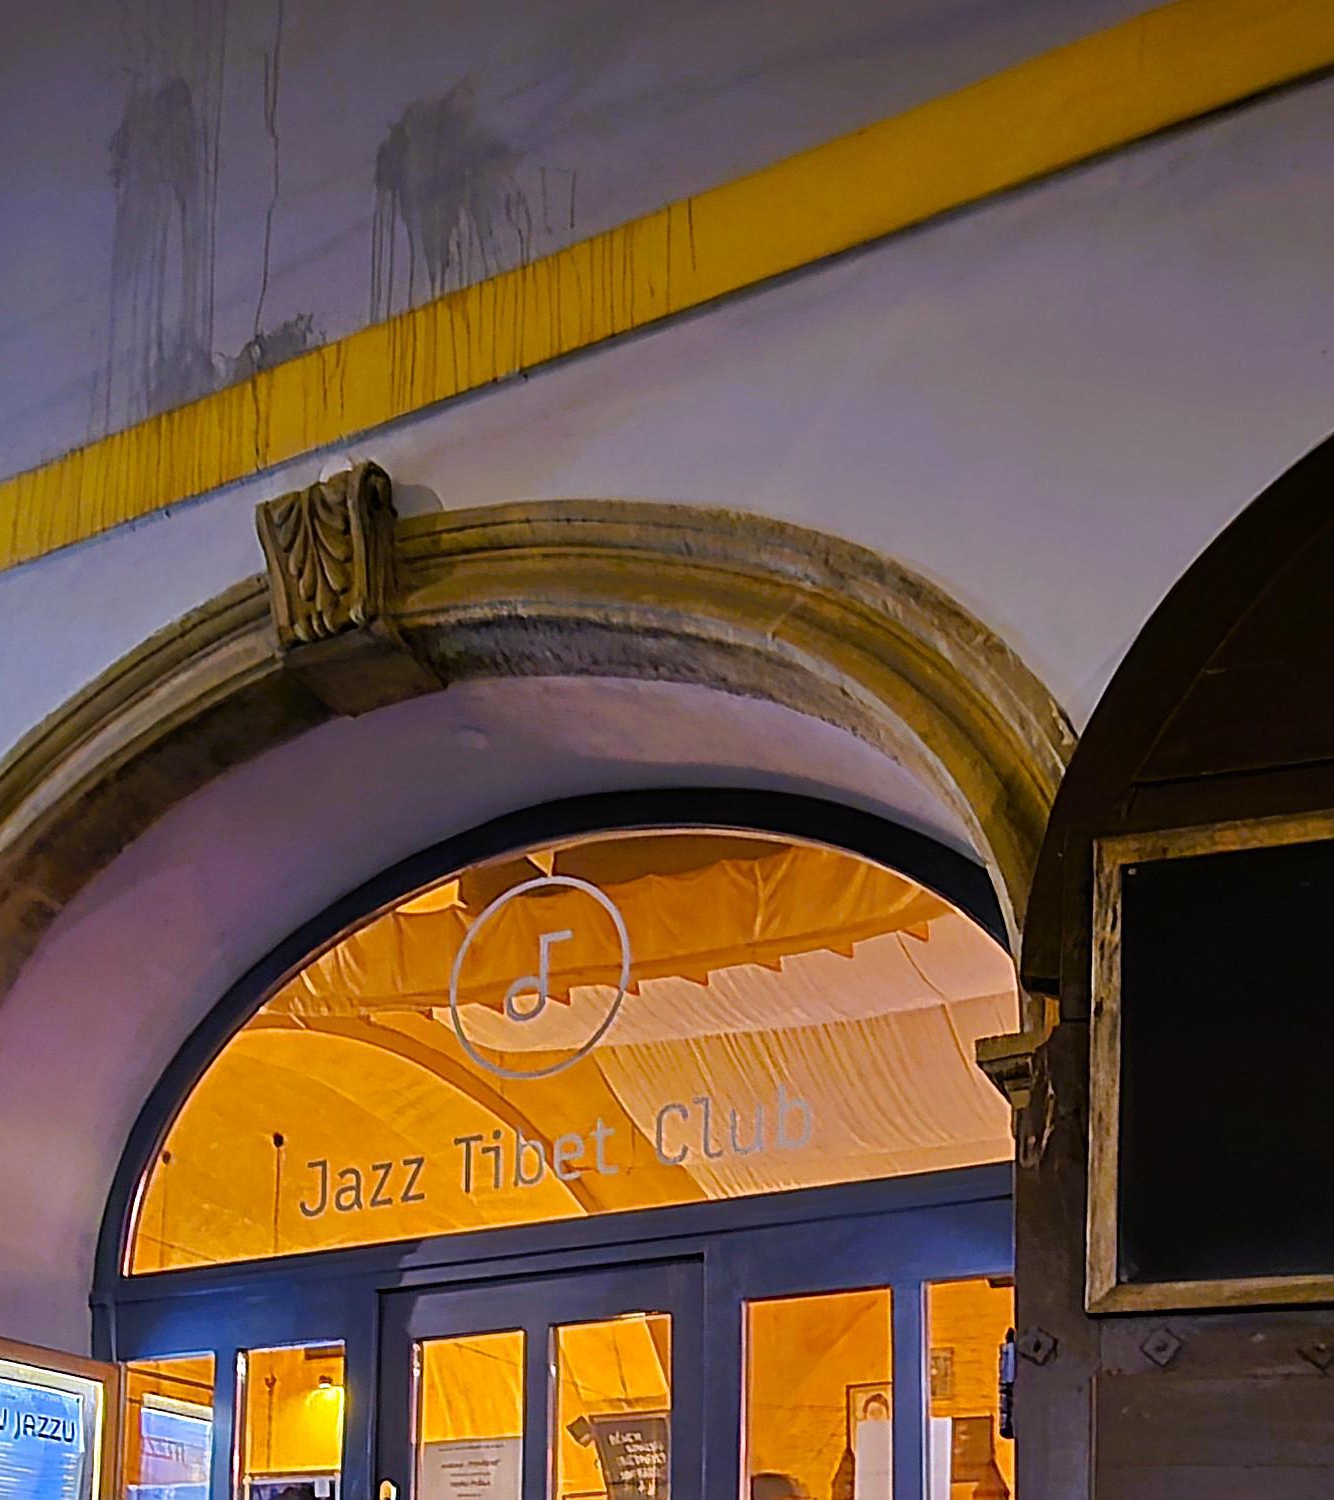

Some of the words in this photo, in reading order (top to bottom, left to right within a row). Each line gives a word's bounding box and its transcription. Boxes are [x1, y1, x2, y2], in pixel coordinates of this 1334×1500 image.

[299, 1156, 426, 1217] Jazz
[453, 1116, 619, 1193] Tibet
[656, 1083, 813, 1166] Club
[13, 1410, 75, 1443] JAZZU
